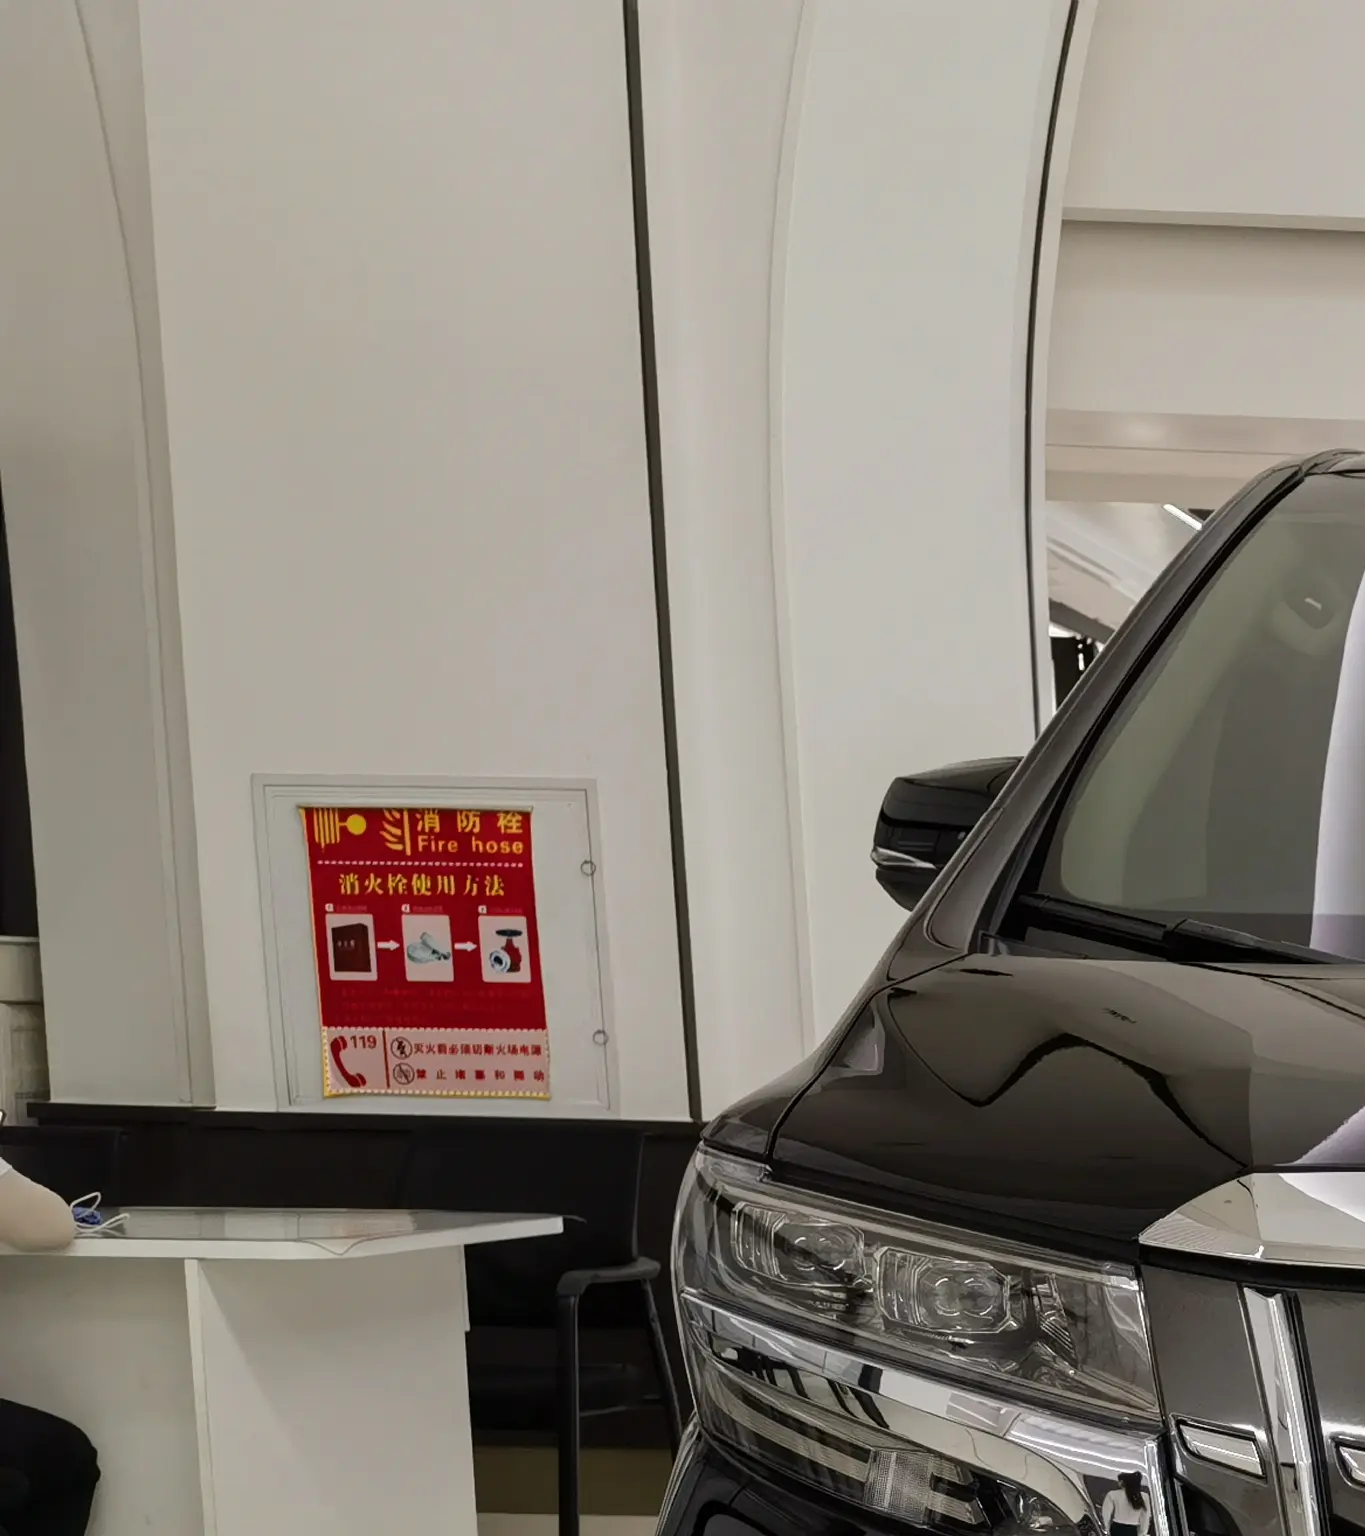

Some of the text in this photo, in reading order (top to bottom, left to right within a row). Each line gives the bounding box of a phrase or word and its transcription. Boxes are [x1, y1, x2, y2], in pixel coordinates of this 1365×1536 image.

[415, 809, 524, 834] 消防栓
[417, 835, 524, 854] Fire hose
[338, 872, 505, 896] 消火栓使用方法
[350, 1034, 377, 1050] 119
